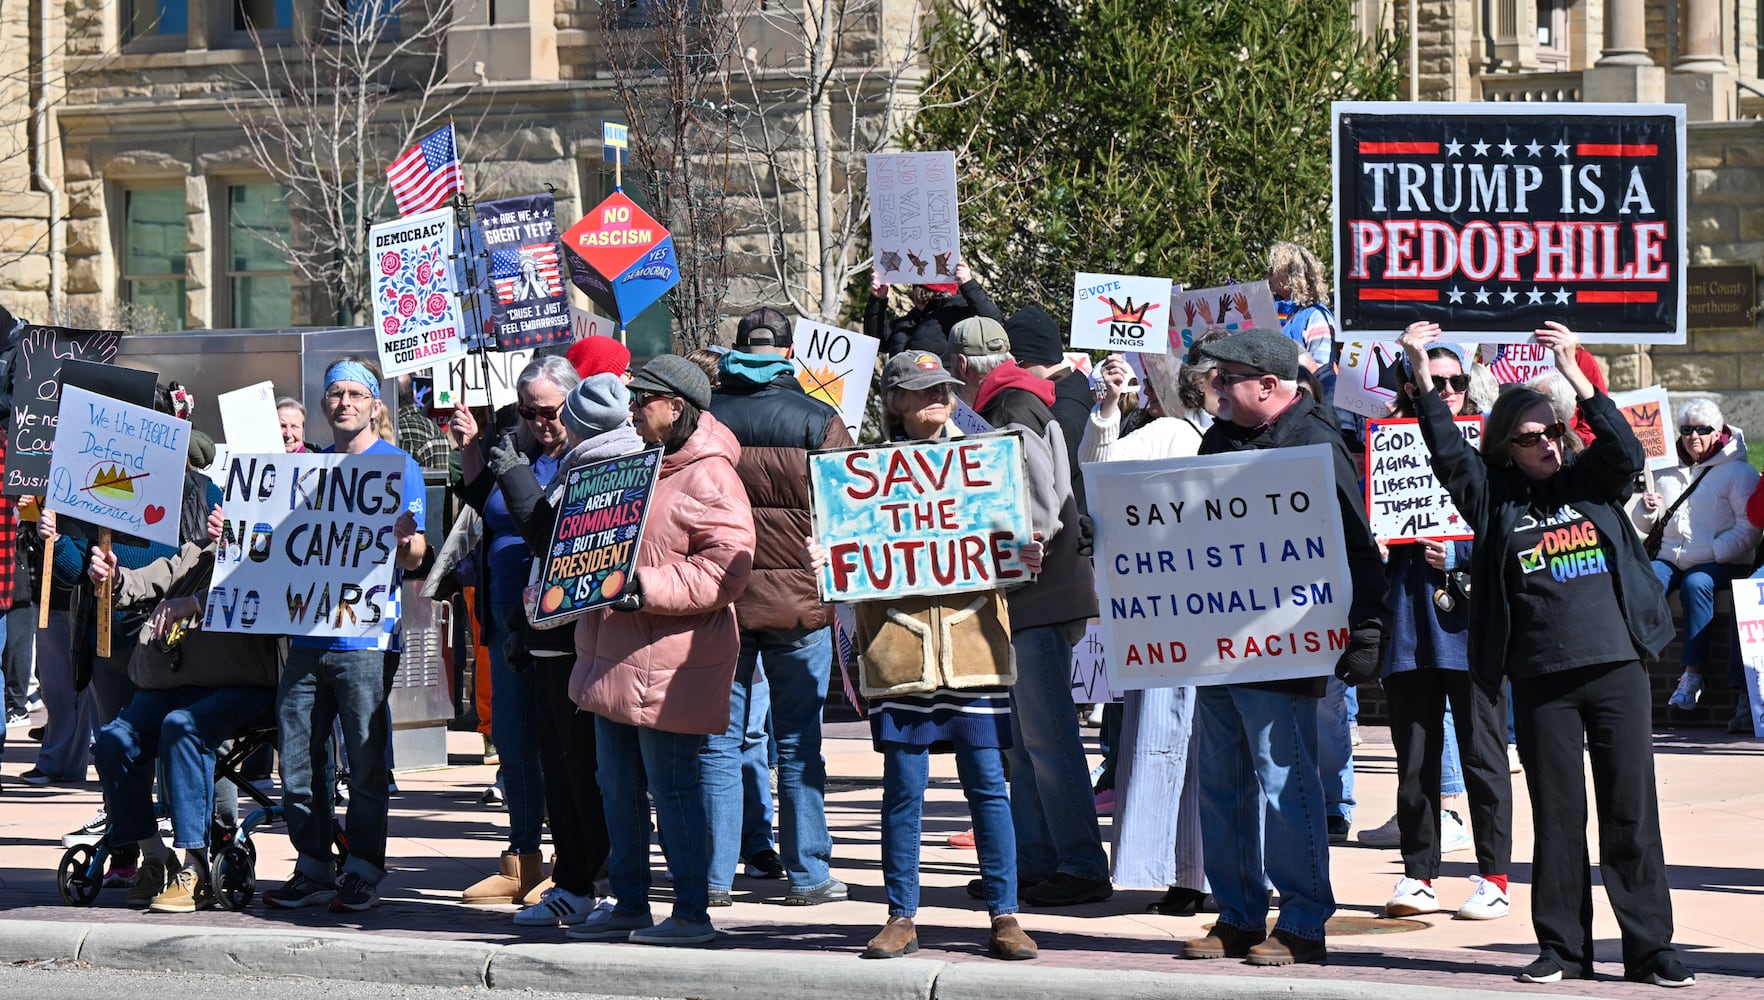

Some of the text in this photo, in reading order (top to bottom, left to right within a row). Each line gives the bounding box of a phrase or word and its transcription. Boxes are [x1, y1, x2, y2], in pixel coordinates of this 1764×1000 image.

[875, 156, 894, 190] NO
[895, 156, 922, 243] NO WAR
[1363, 162, 1656, 214] TRUMP IS A
[500, 209, 531, 225] ARE WE
[603, 206, 630, 225] NO
[926, 189, 952, 252] KING
[376, 221, 446, 248] DEMOCRACY
[485, 221, 553, 245] GREAT YET?
[578, 230, 653, 246] FASCISM
[648, 247, 668, 261] YES
[1348, 219, 1670, 281] PEDOPHILE
[622, 267, 674, 284] DEMOCRACY
[1088, 280, 1122, 297] VOTE
[1688, 281, 1747, 297] ami County
[535, 304, 542, 317] I
[543, 301, 561, 315] JUST
[1688, 300, 1742, 314] ourthouse
[384, 326, 456, 353] NEEDS YOUR
[501, 322, 519, 336] FEEL
[575, 315, 598, 337] NO
[1109, 323, 1145, 339] NO
[394, 341, 447, 364] COURAGE
[806, 328, 851, 364] NO
[1108, 338, 1145, 347] KINGS
[1505, 343, 1547, 362] EFEND
[15, 404, 59, 430] We ne
[88, 402, 181, 451] We the PEOPLE
[77, 430, 148, 471] Defend
[1374, 431, 1415, 452] GOD
[846, 443, 993, 500] SAVE
[1373, 473, 1433, 496] LIBERTY
[52, 466, 145, 532] Democracy
[225, 458, 277, 503] NO
[289, 466, 402, 516] KINGS
[567, 467, 652, 505] IMMIGRANTS
[584, 489, 625, 513] AREN'T
[1126, 491, 1311, 527] SAY NO TO
[880, 498, 959, 533] THE
[1399, 512, 1440, 536] ALL
[217, 519, 395, 568] NO CAMPS
[572, 527, 619, 554] BUT THE
[1543, 520, 1598, 555] DRAG
[548, 539, 634, 582] PRESIDENT
[830, 530, 1024, 592] FUTURE
[1115, 536, 1326, 575] CHRISTIAN
[574, 574, 593, 601] IS
[1111, 582, 1334, 620] NATIONALISM
[204, 581, 387, 631] NO WARS
[1125, 627, 1350, 667] AND RACISM
